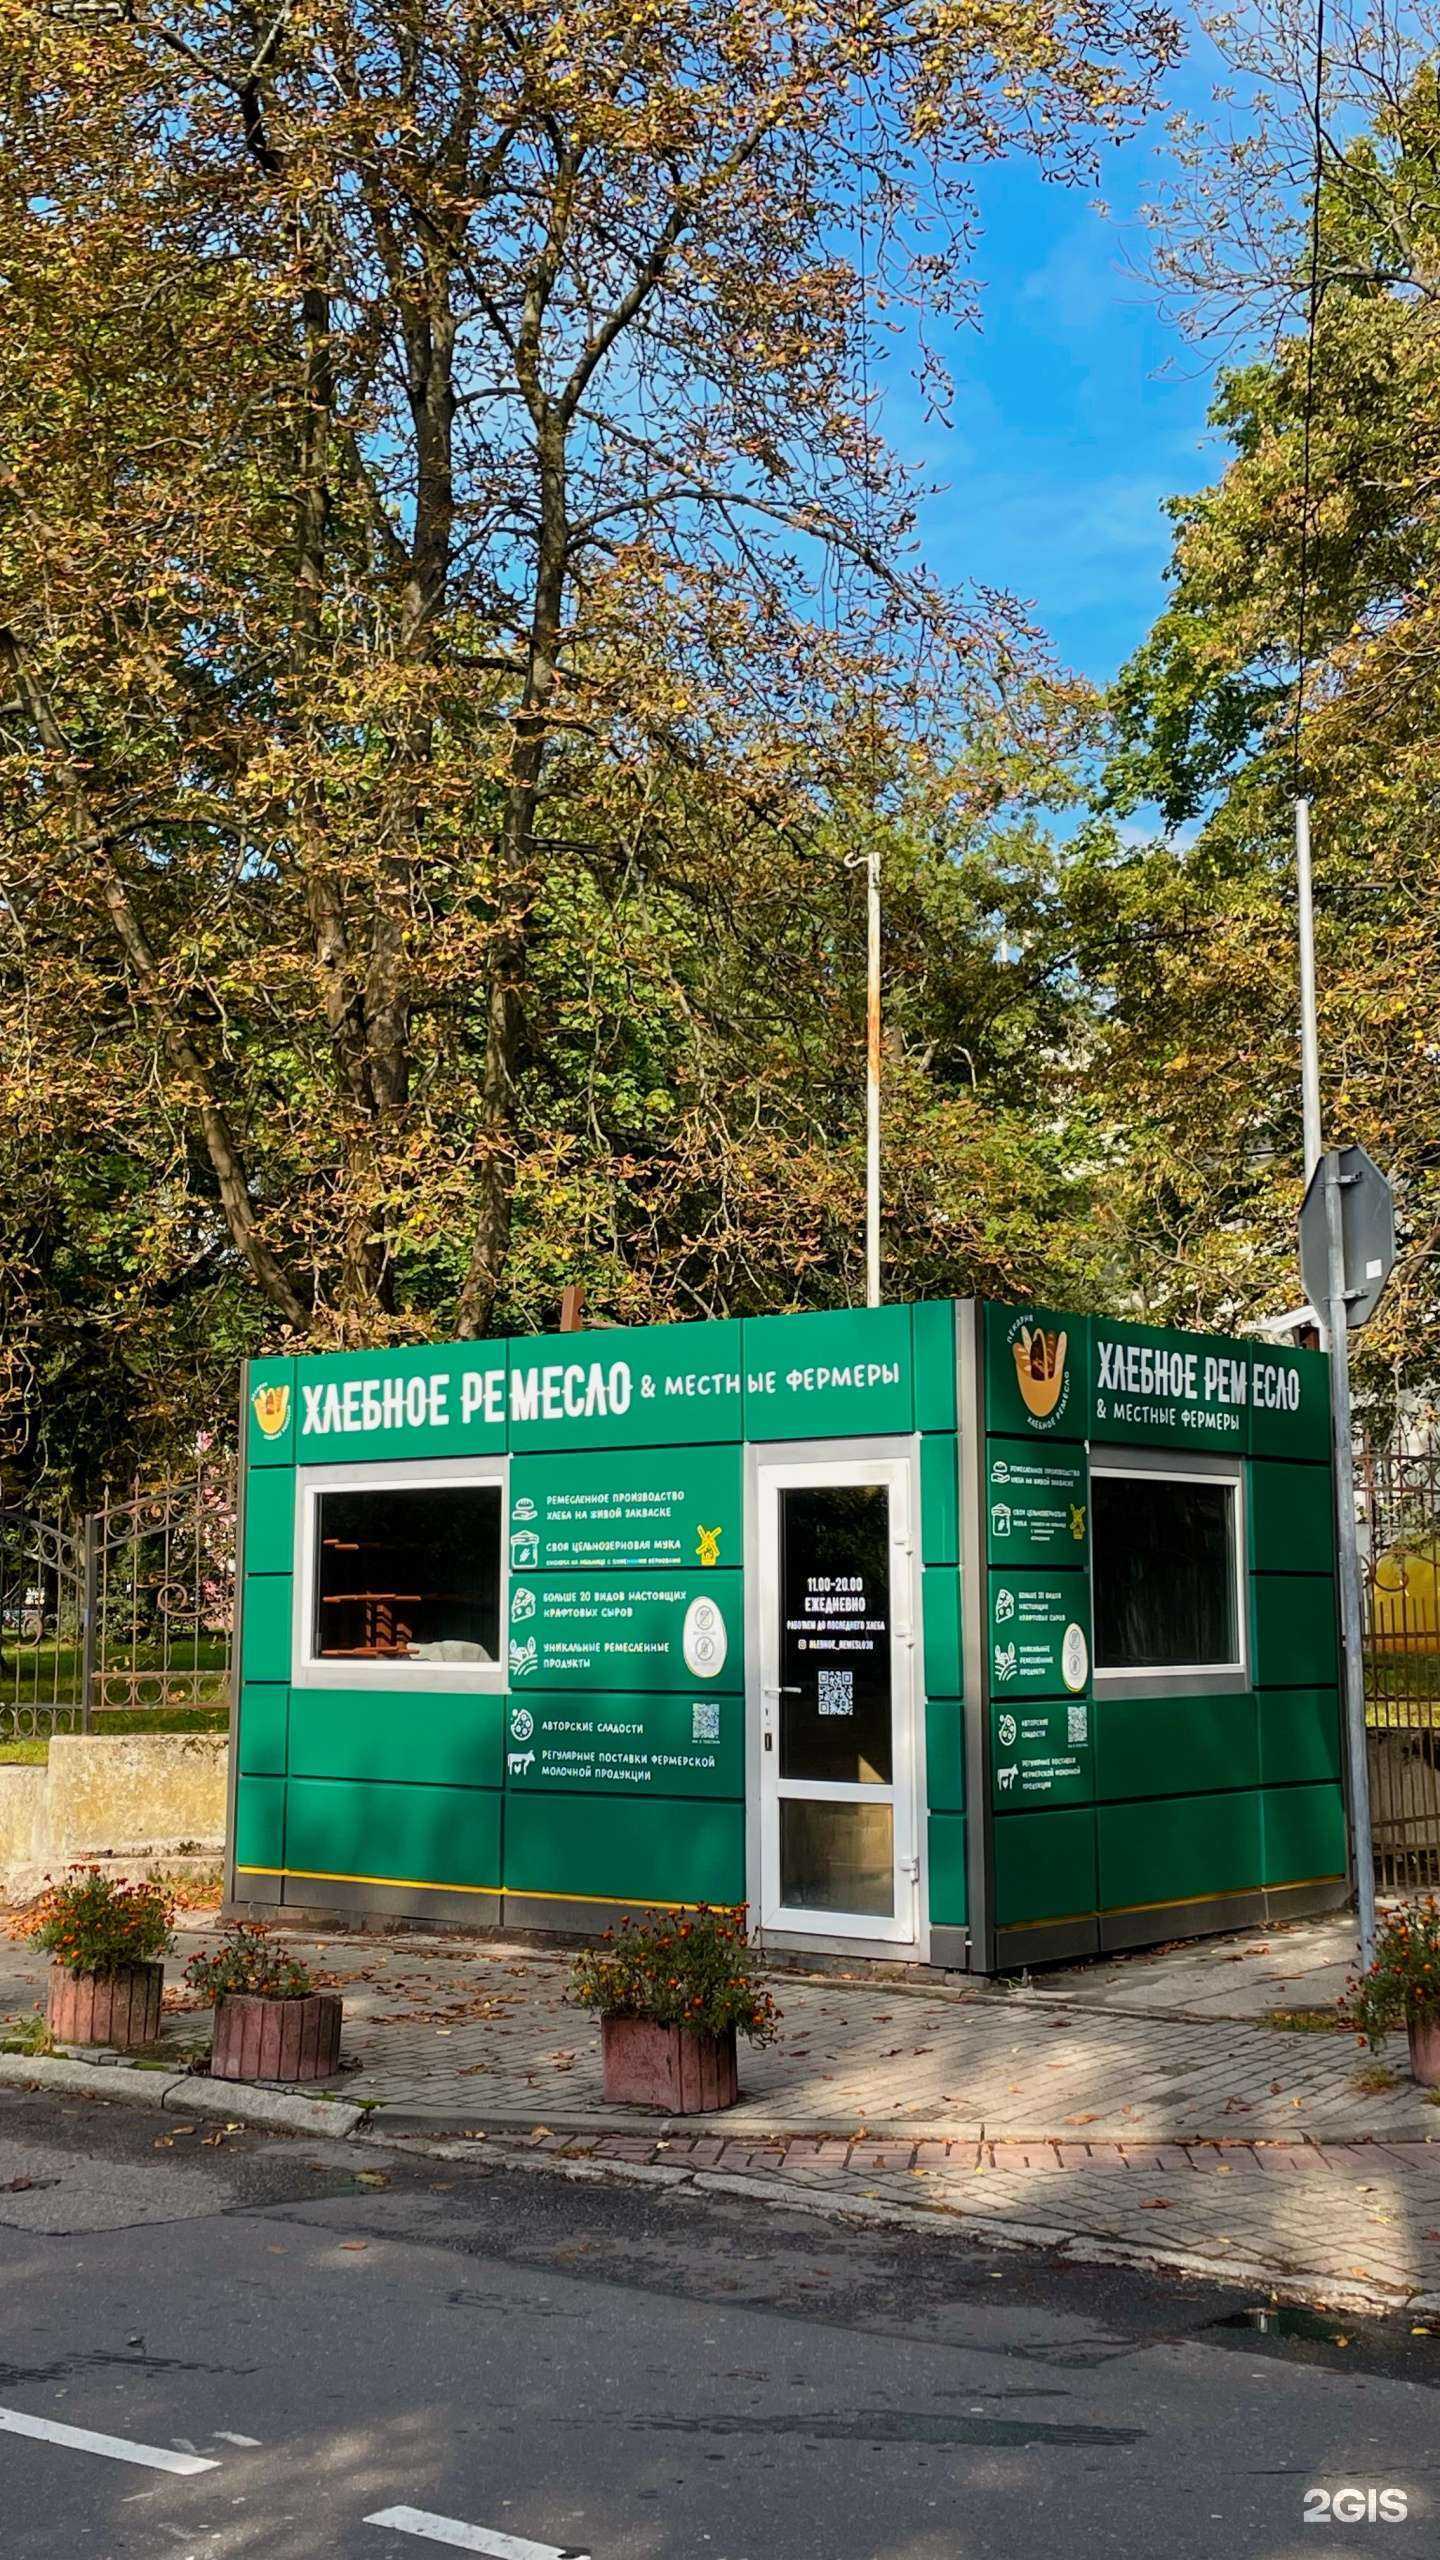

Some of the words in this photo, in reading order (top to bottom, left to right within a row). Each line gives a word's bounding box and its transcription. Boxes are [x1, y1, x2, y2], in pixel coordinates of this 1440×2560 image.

[1097, 1341, 1198, 1400] ХЛЕБНОЕ
[1203, 1356, 1300, 1411] РЕМЕСЛО
[302, 1373, 450, 1435] ХЛЕБНОЕ
[460, 1361, 633, 1423] РЕМЕСЛО
[640, 1374, 656, 1398] &
[664, 1371, 776, 1396] МЕСТНЫЕ
[786, 1362, 900, 1392] ФЕРМЕРЫ
[1097, 1399, 1107, 1419] &
[1113, 1403, 1176, 1426] МЕСТНЫЕ
[1181, 1410, 1240, 1430] ФЕРМЕРЫ
[547, 1494, 609, 1505] РЕМЕСЛЕННОЕ
[613, 1491, 685, 1502] ПРОИЗВОДСТВО
[546, 1510, 572, 1520] ХЛЕБА
[575, 1510, 587, 1519] НА
[590, 1508, 622, 1519] ЖИВОЙ
[626, 1507, 671, 1518] ЗАКВАСКЕ
[546, 1542, 570, 1552] СВОЯ
[572, 1541, 651, 1553] ЦЕЛЬНОЗЕРНОВАЯ
[654, 1540, 681, 1549] МУКА
[807, 1577, 863, 1592] 11.00-20.00
[543, 1592, 576, 1602] БОЛЬШЕ
[580, 1592, 591, 1601] 20
[594, 1592, 625, 1602] ВИДОВ
[628, 1591, 686, 1602] НАСТОЯЩИХ
[804, 1597, 866, 1614] ЕЖЕДНЕВНО
[544, 1608, 598, 1618] КРАФТОВЫХ
[601, 1608, 633, 1618] СЫРОВ
[543, 1643, 600, 1653] УНИКАЛЬНЫЕ
[604, 1643, 669, 1653] РЕМЕСЛЕННЫЕ
[543, 1659, 590, 1669] ПРОДУКТЫ
[541, 1721, 593, 1732] АВТОРСКИЕ
[597, 1723, 644, 1734] СЛАДОСТИ
[542, 1750, 595, 1762] РЕГУЛЯРНЫЕ
[599, 1753, 647, 1764] ПОСТАВКИ
[651, 1755, 715, 1768] ФЕРМЕРСКОЙ
[541, 1766, 591, 1778] МОЛОЧНОЙ
[595, 1768, 651, 1781] ПРОДУКЦИИ
